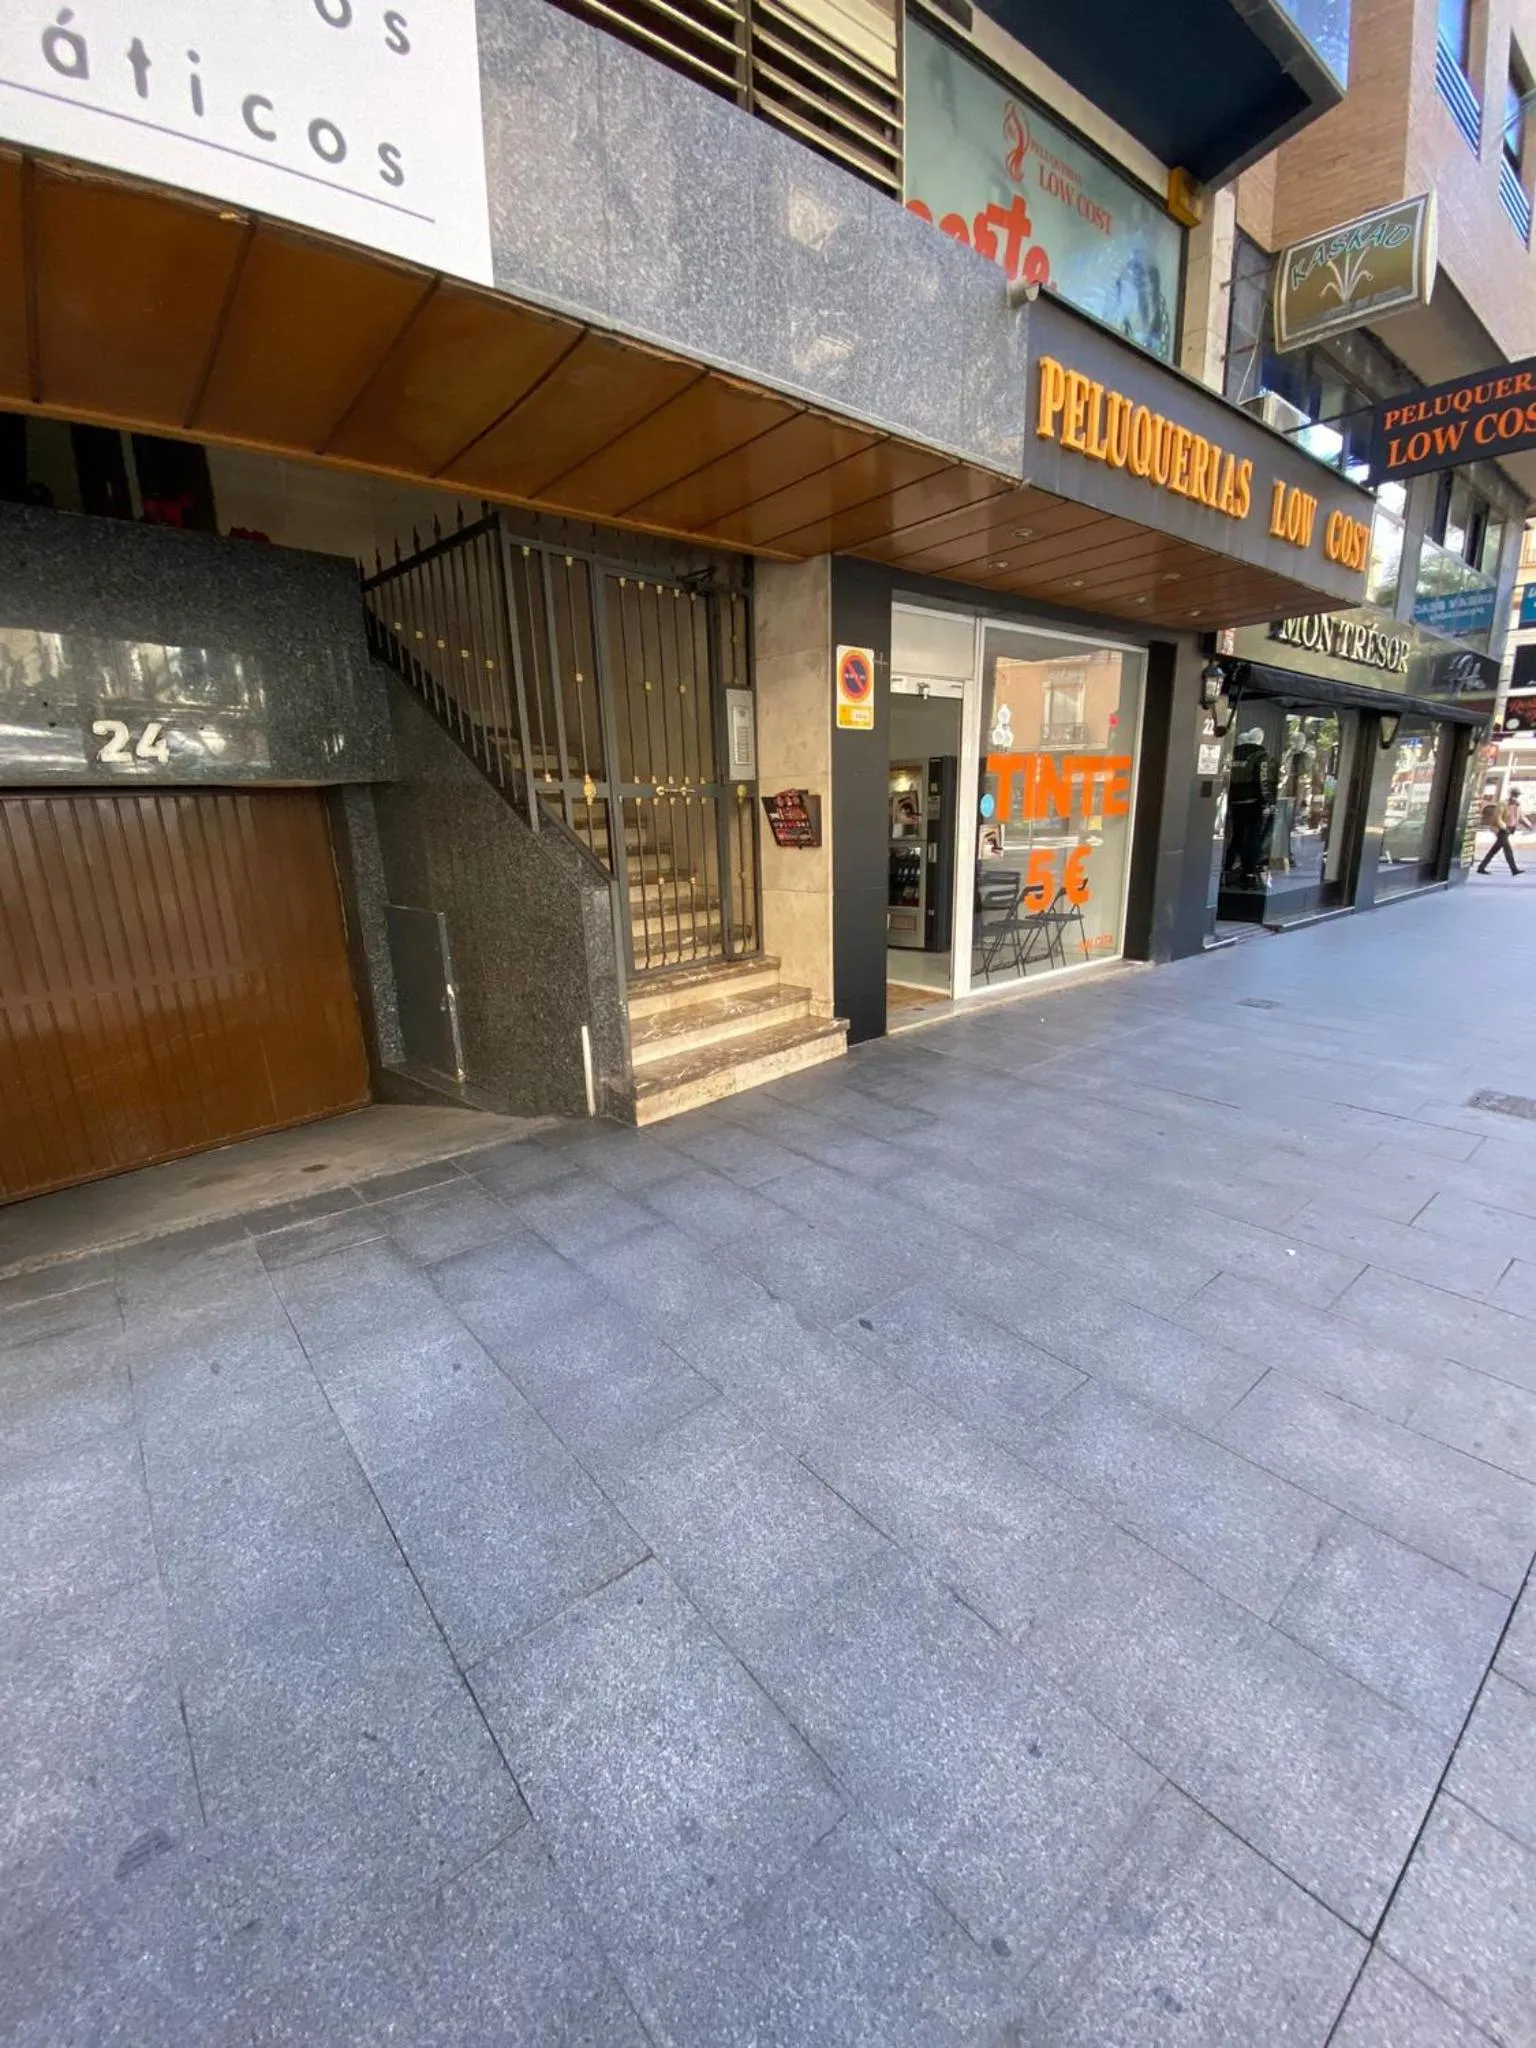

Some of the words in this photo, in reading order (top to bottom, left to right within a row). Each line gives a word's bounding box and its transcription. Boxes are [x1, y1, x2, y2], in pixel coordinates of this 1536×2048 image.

[1038, 163, 1076, 208] LOW
[1076, 192, 1112, 235] COST
[1037, 355, 1254, 520] PELUQUERIAS
[1269, 478, 1317, 548] LOW
[1325, 507, 1371, 573] COST
[1387, 420, 1469, 468] LOW
[1279, 613, 1334, 653] MON
[1339, 620, 1411, 674] TRÉSOR
[92, 720, 171, 765] 24
[986, 752, 1132, 824] TINTE
